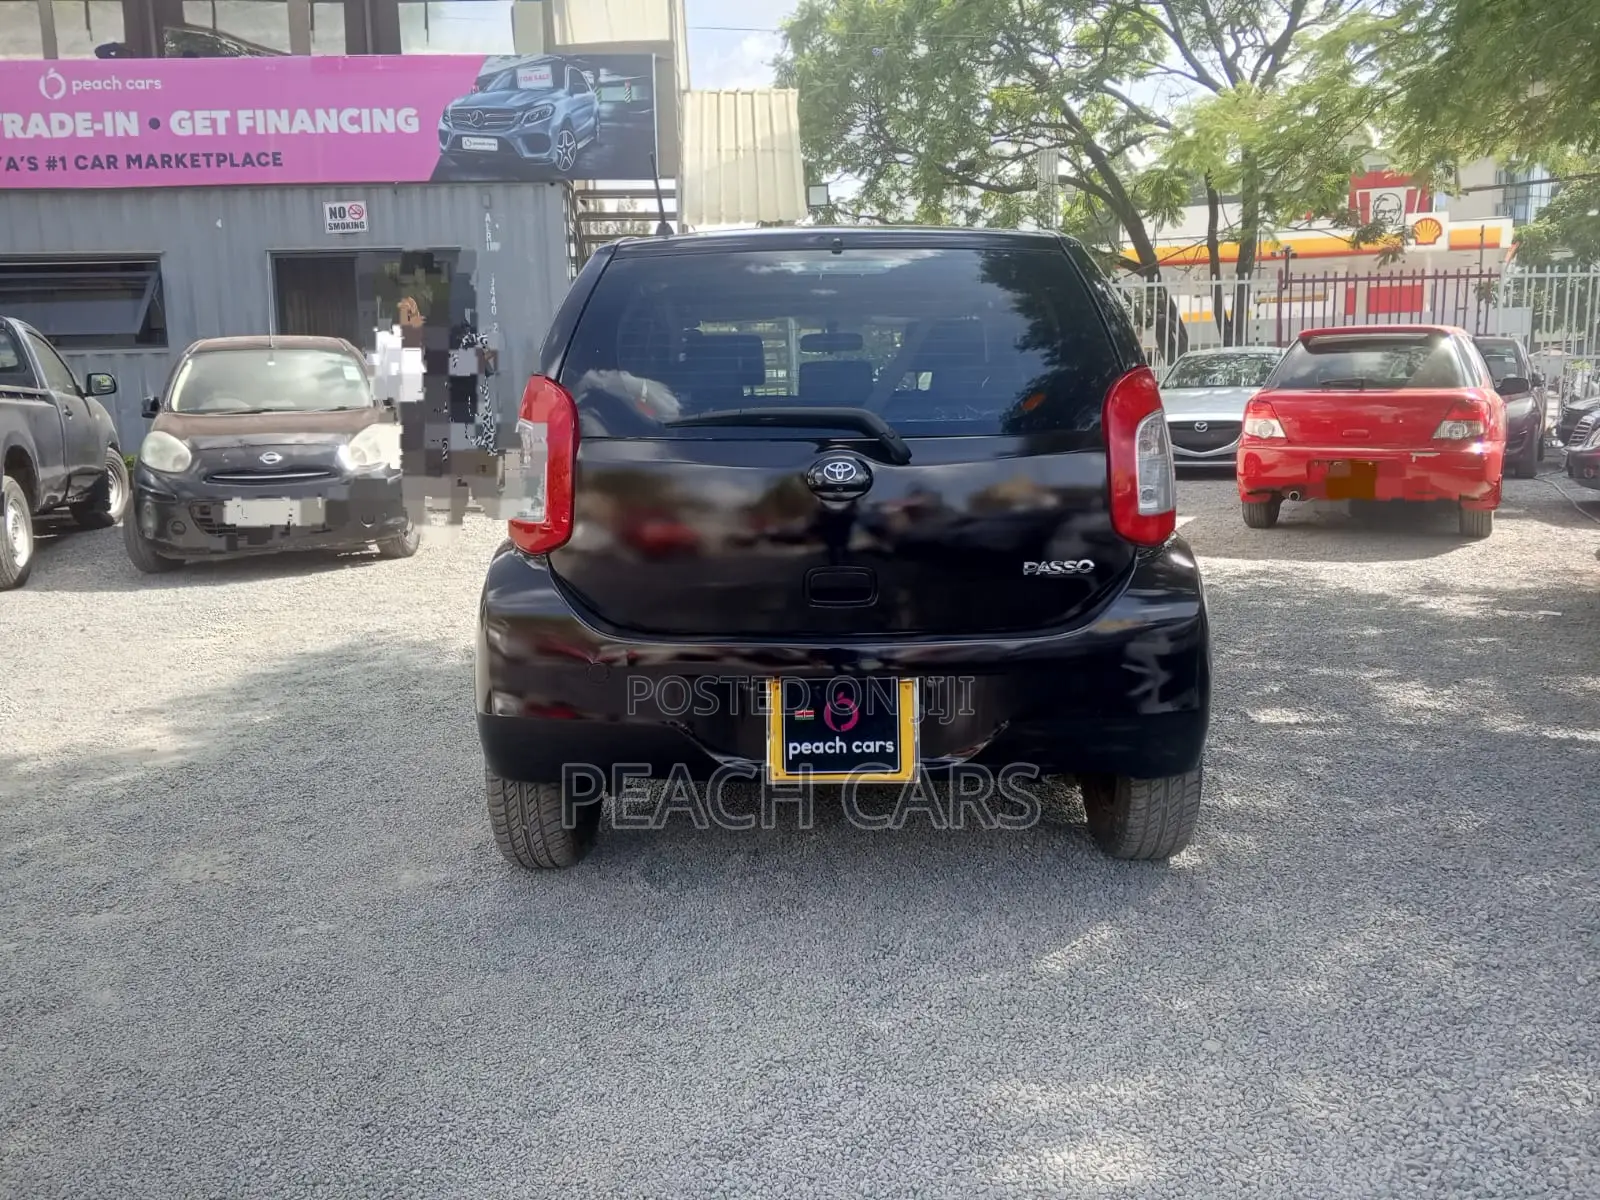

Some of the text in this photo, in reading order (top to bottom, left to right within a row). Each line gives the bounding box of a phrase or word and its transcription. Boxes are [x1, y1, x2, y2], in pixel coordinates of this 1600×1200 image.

[72, 75, 162, 95] peach cars
[0, 107, 420, 139] RADE-IN GET FINANCING
[0, 151, 283, 172] A'S #1 CAR MARKETPLACE
[328, 206, 347, 219] NO
[328, 221, 366, 231] SMOKING
[1023, 559, 1095, 575] PASSO
[788, 735, 895, 760] peach cars
